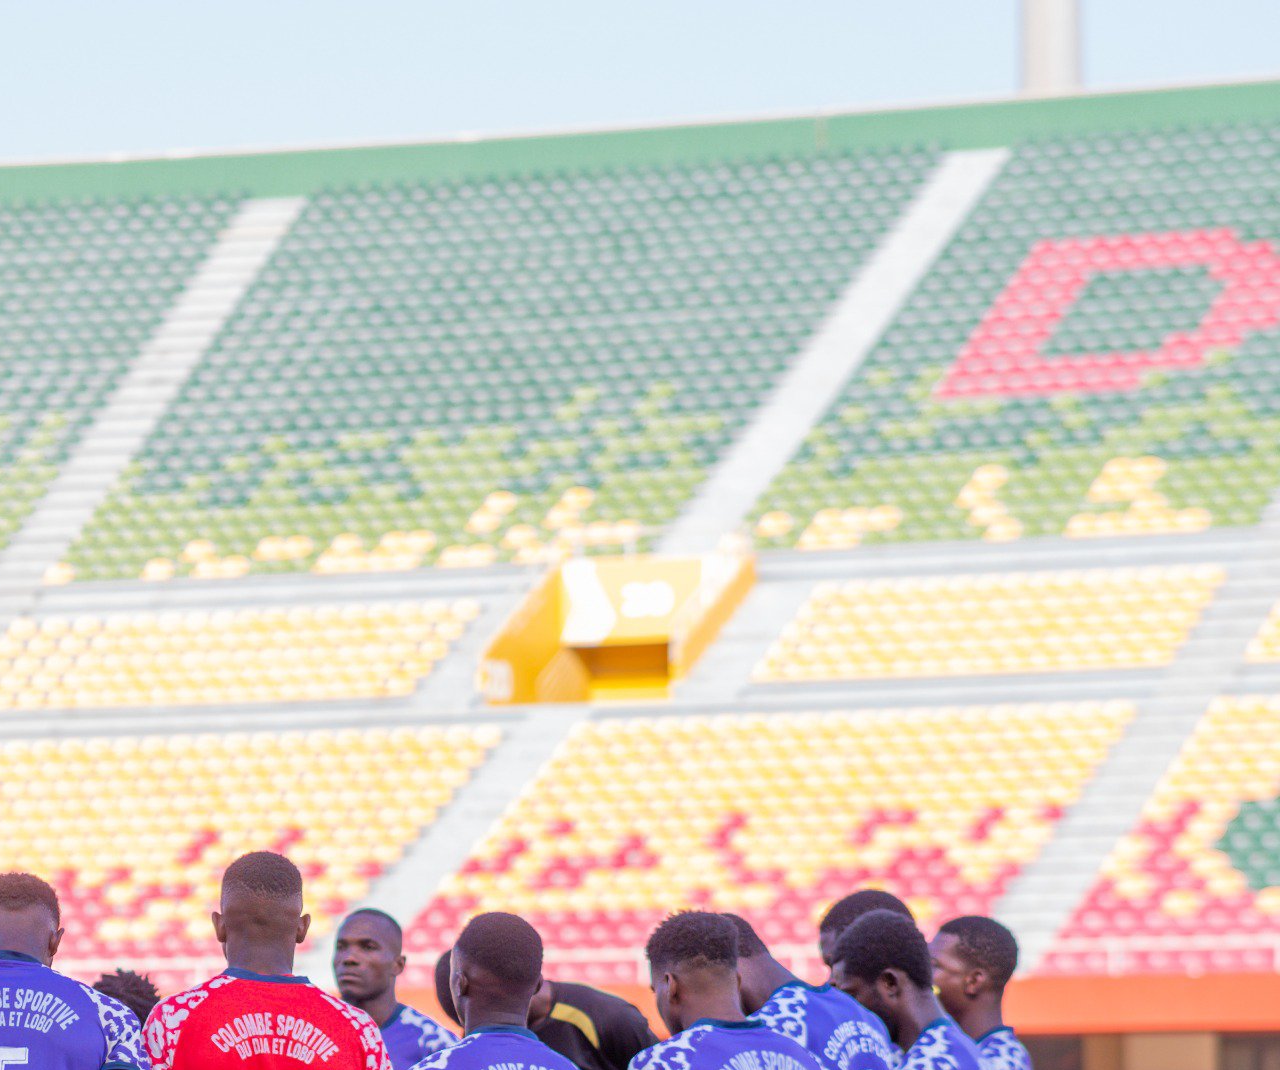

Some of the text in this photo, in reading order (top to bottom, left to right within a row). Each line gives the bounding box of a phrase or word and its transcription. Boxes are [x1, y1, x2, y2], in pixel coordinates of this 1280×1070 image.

[8, 1011, 23, 1027] ET
[24, 1012, 54, 1034] LOBO
[14, 988, 80, 1031] SPORTIVE
[210, 1012, 340, 1062] COLOMBE SPORTIVE
[235, 1038, 316, 1065] DU DJA ET LOBO
